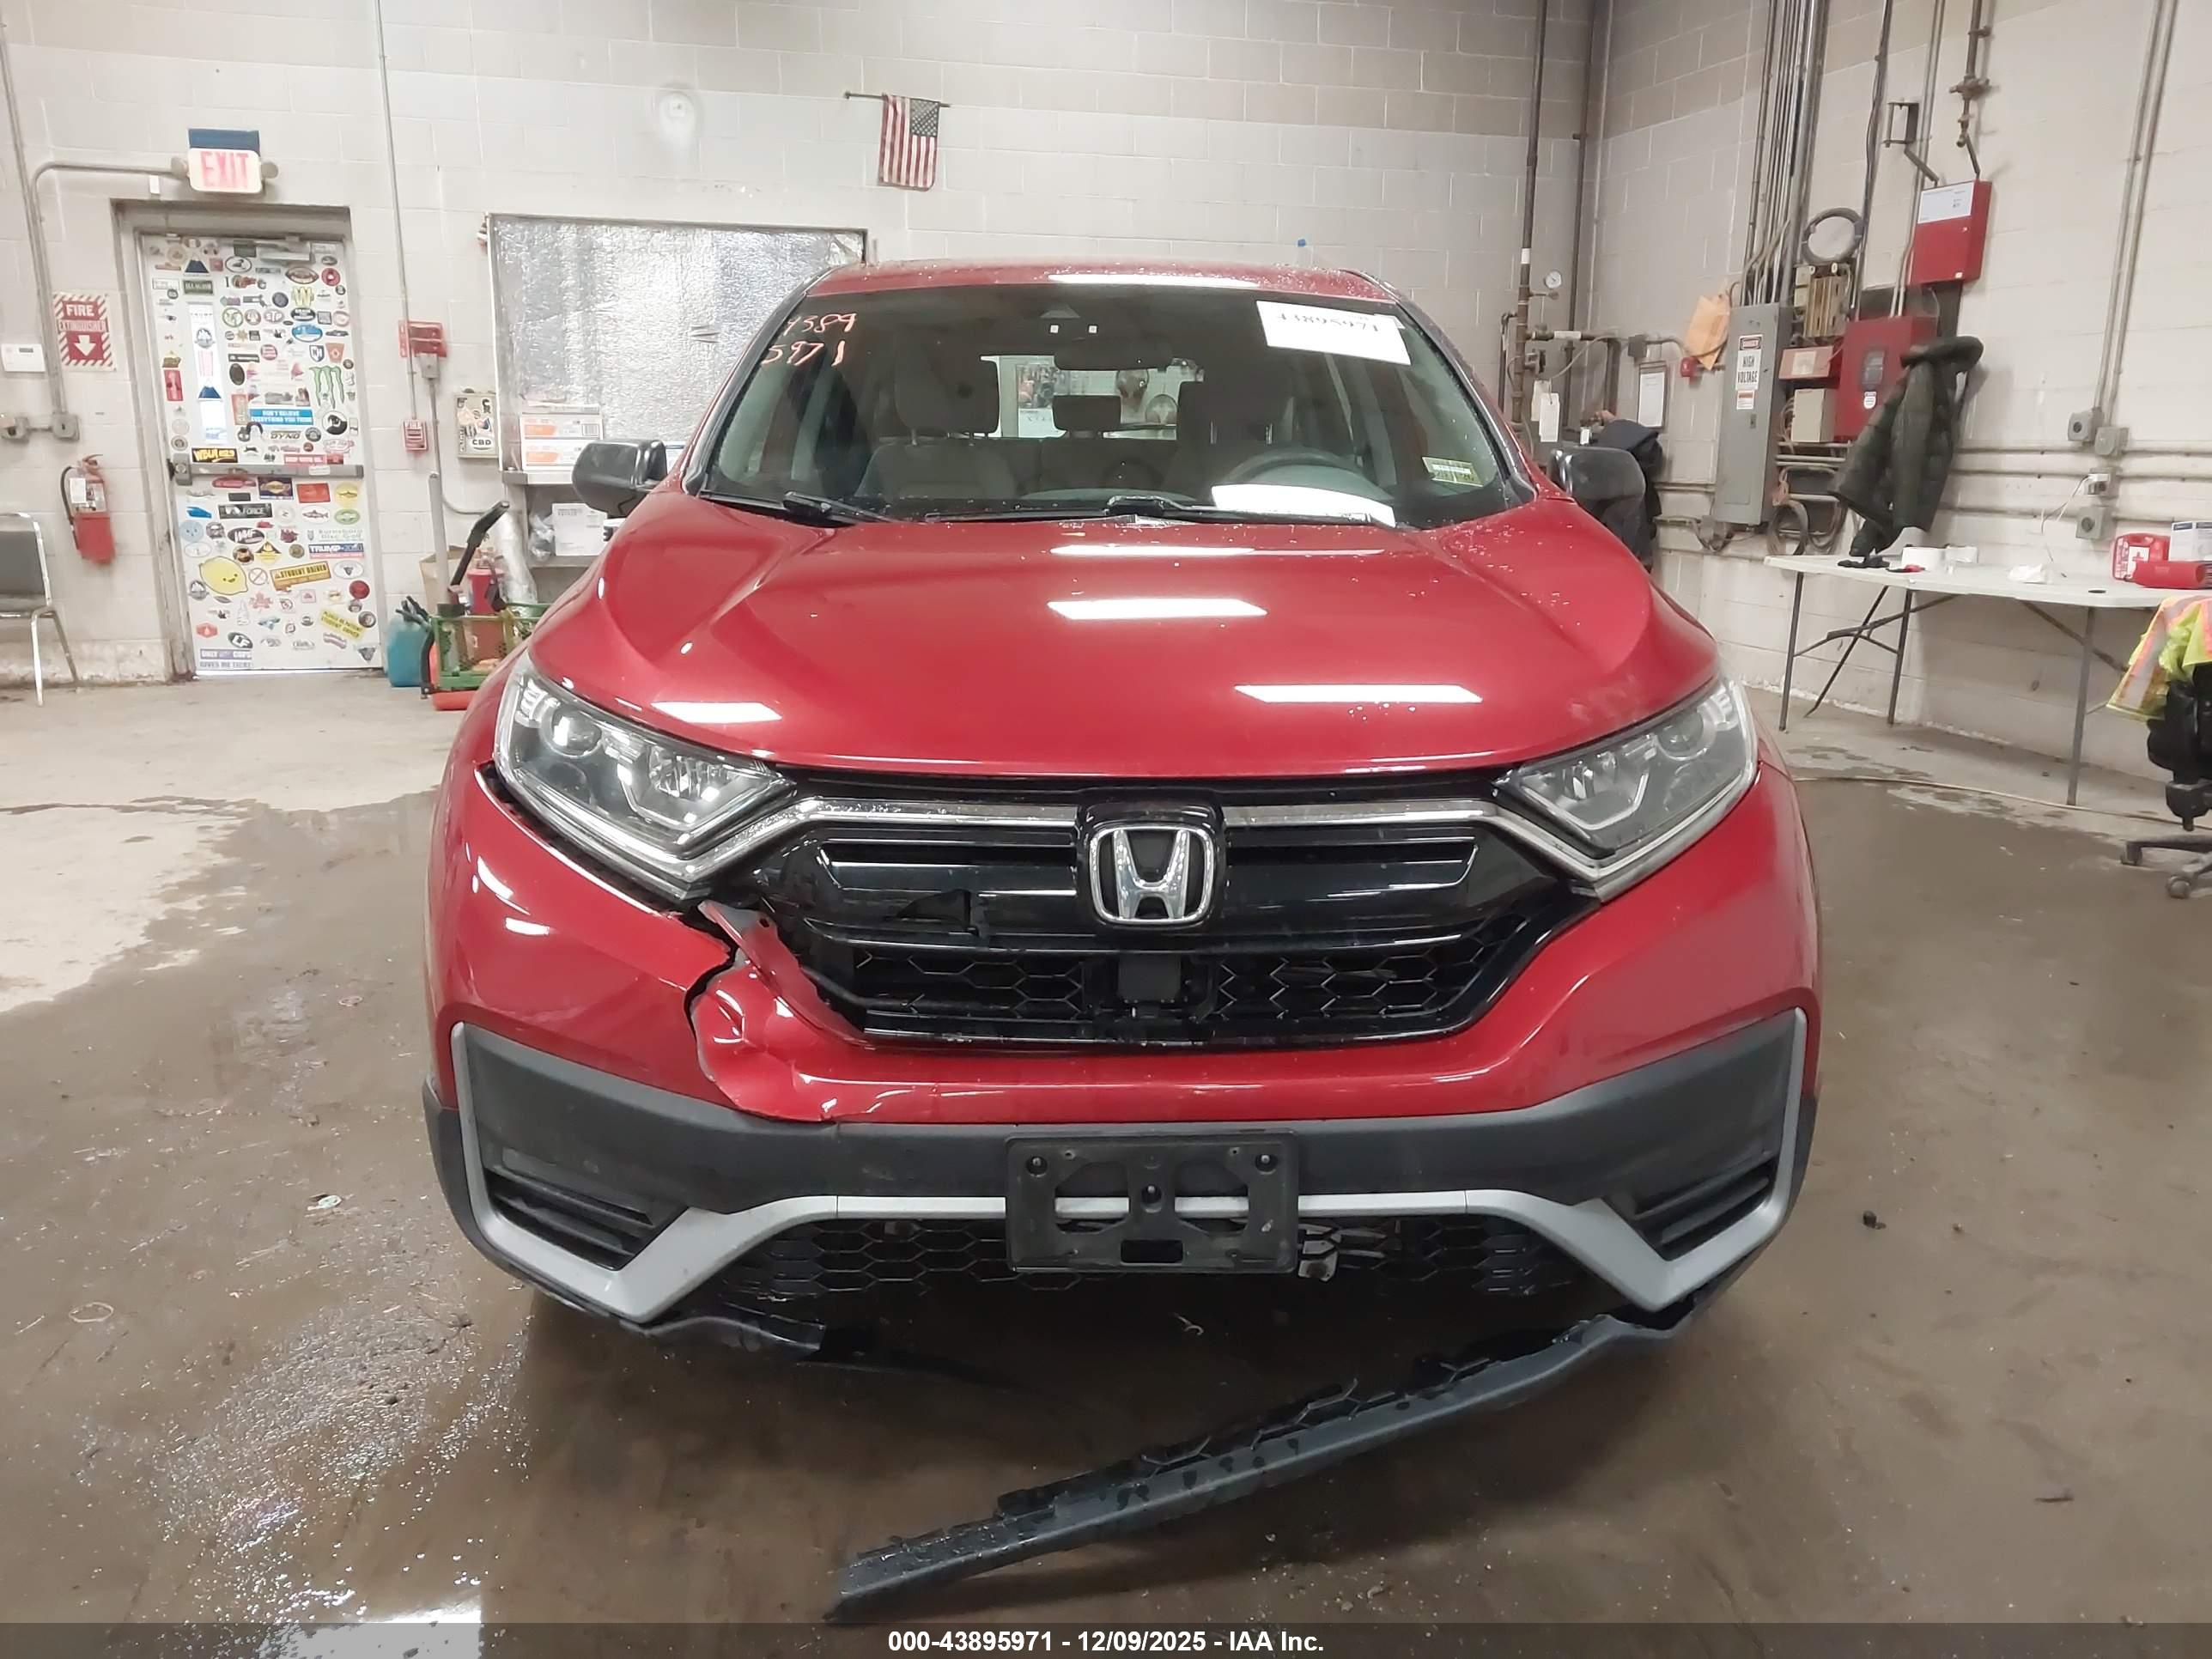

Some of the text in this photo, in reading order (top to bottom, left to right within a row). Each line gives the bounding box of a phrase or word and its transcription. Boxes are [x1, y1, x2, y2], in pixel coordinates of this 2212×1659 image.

[201, 150, 249, 188] EXIT
[66, 303, 95, 317] FIRE
[264, 311, 283, 322] STP
[1742, 356, 1755, 368] HIGH
[1738, 371, 1758, 383] VOLTAGE
[281, 564, 327, 578] STUDENT DRIVER
